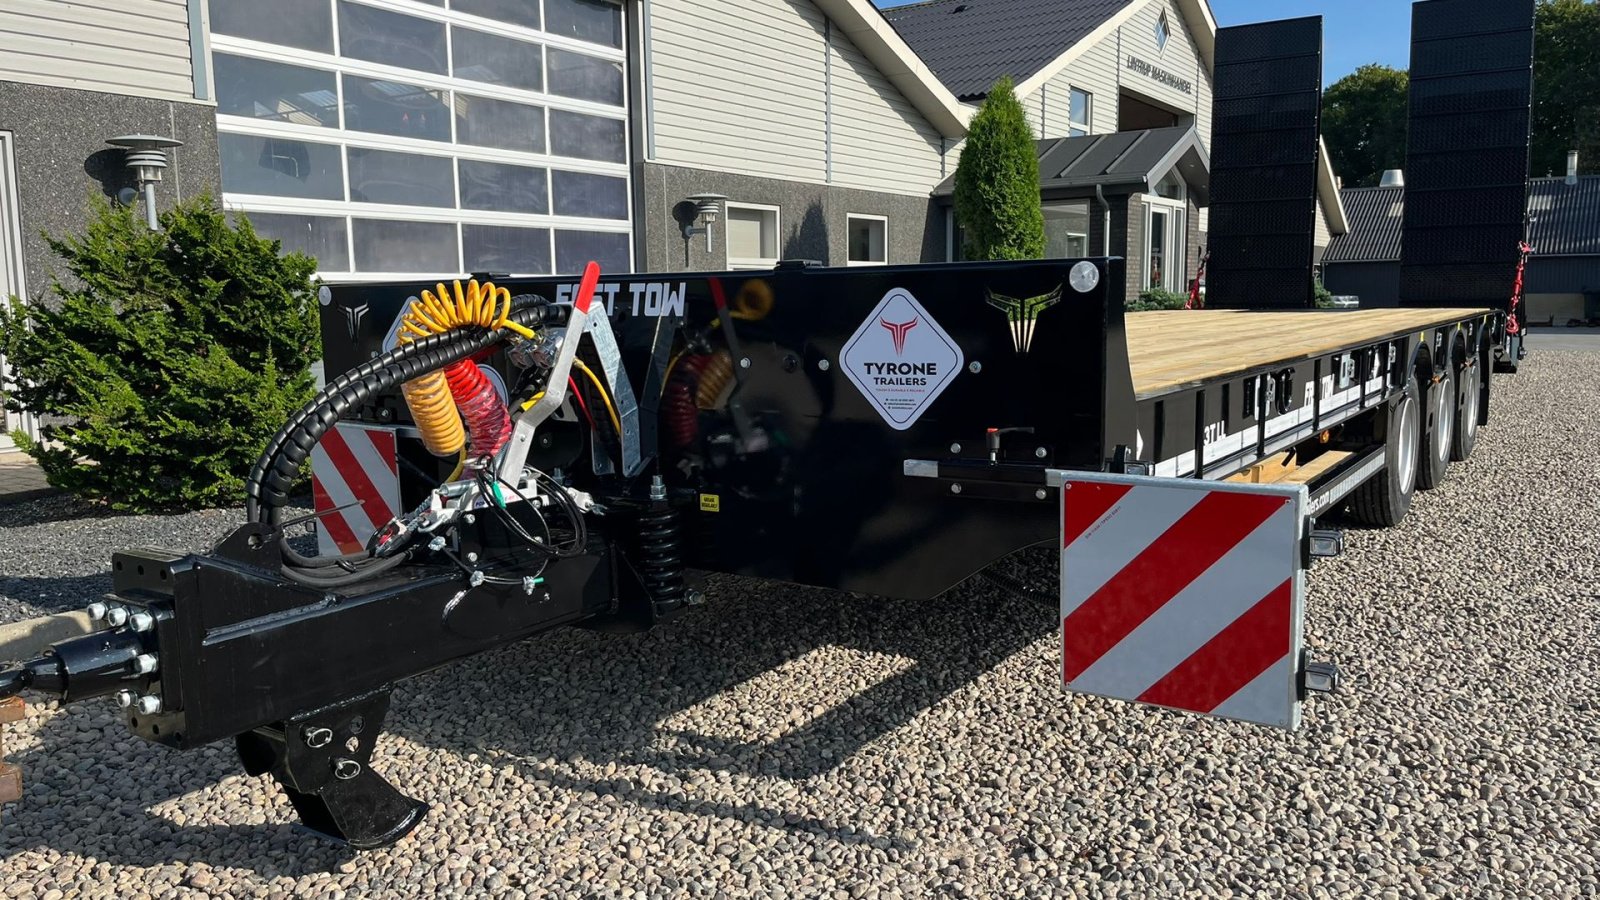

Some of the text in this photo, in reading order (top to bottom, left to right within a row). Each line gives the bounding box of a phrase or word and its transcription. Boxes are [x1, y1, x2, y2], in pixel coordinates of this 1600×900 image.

[629, 282, 686, 317] TOW
[863, 362, 937, 376] TYRONE
[873, 377, 927, 386] TRAILERS
